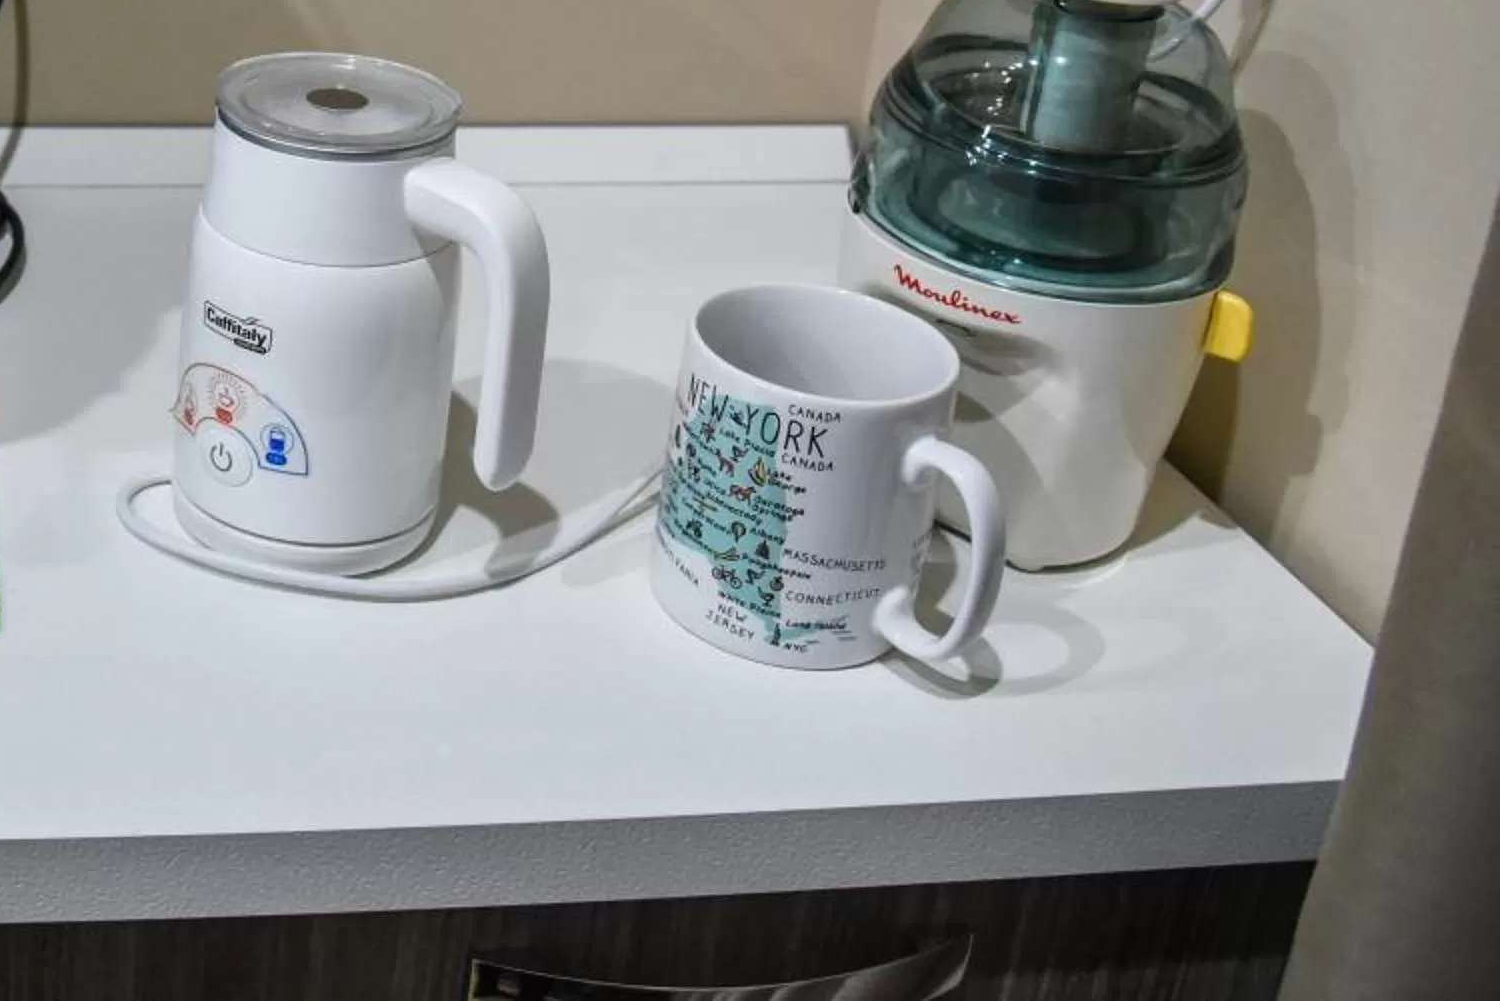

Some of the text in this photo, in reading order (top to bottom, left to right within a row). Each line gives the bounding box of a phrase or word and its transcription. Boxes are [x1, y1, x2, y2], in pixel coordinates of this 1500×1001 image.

[893, 264, 1022, 324] Moulinex
[207, 307, 267, 348] Caffitaly
[687, 373, 729, 422] NEW
[744, 403, 828, 459] YORK
[788, 404, 841, 423] CANADA
[781, 452, 835, 472] CANADA
[785, 587, 881, 606] CONNECTICUT
[717, 603, 748, 623] NEW
[783, 641, 809, 654] NYC
